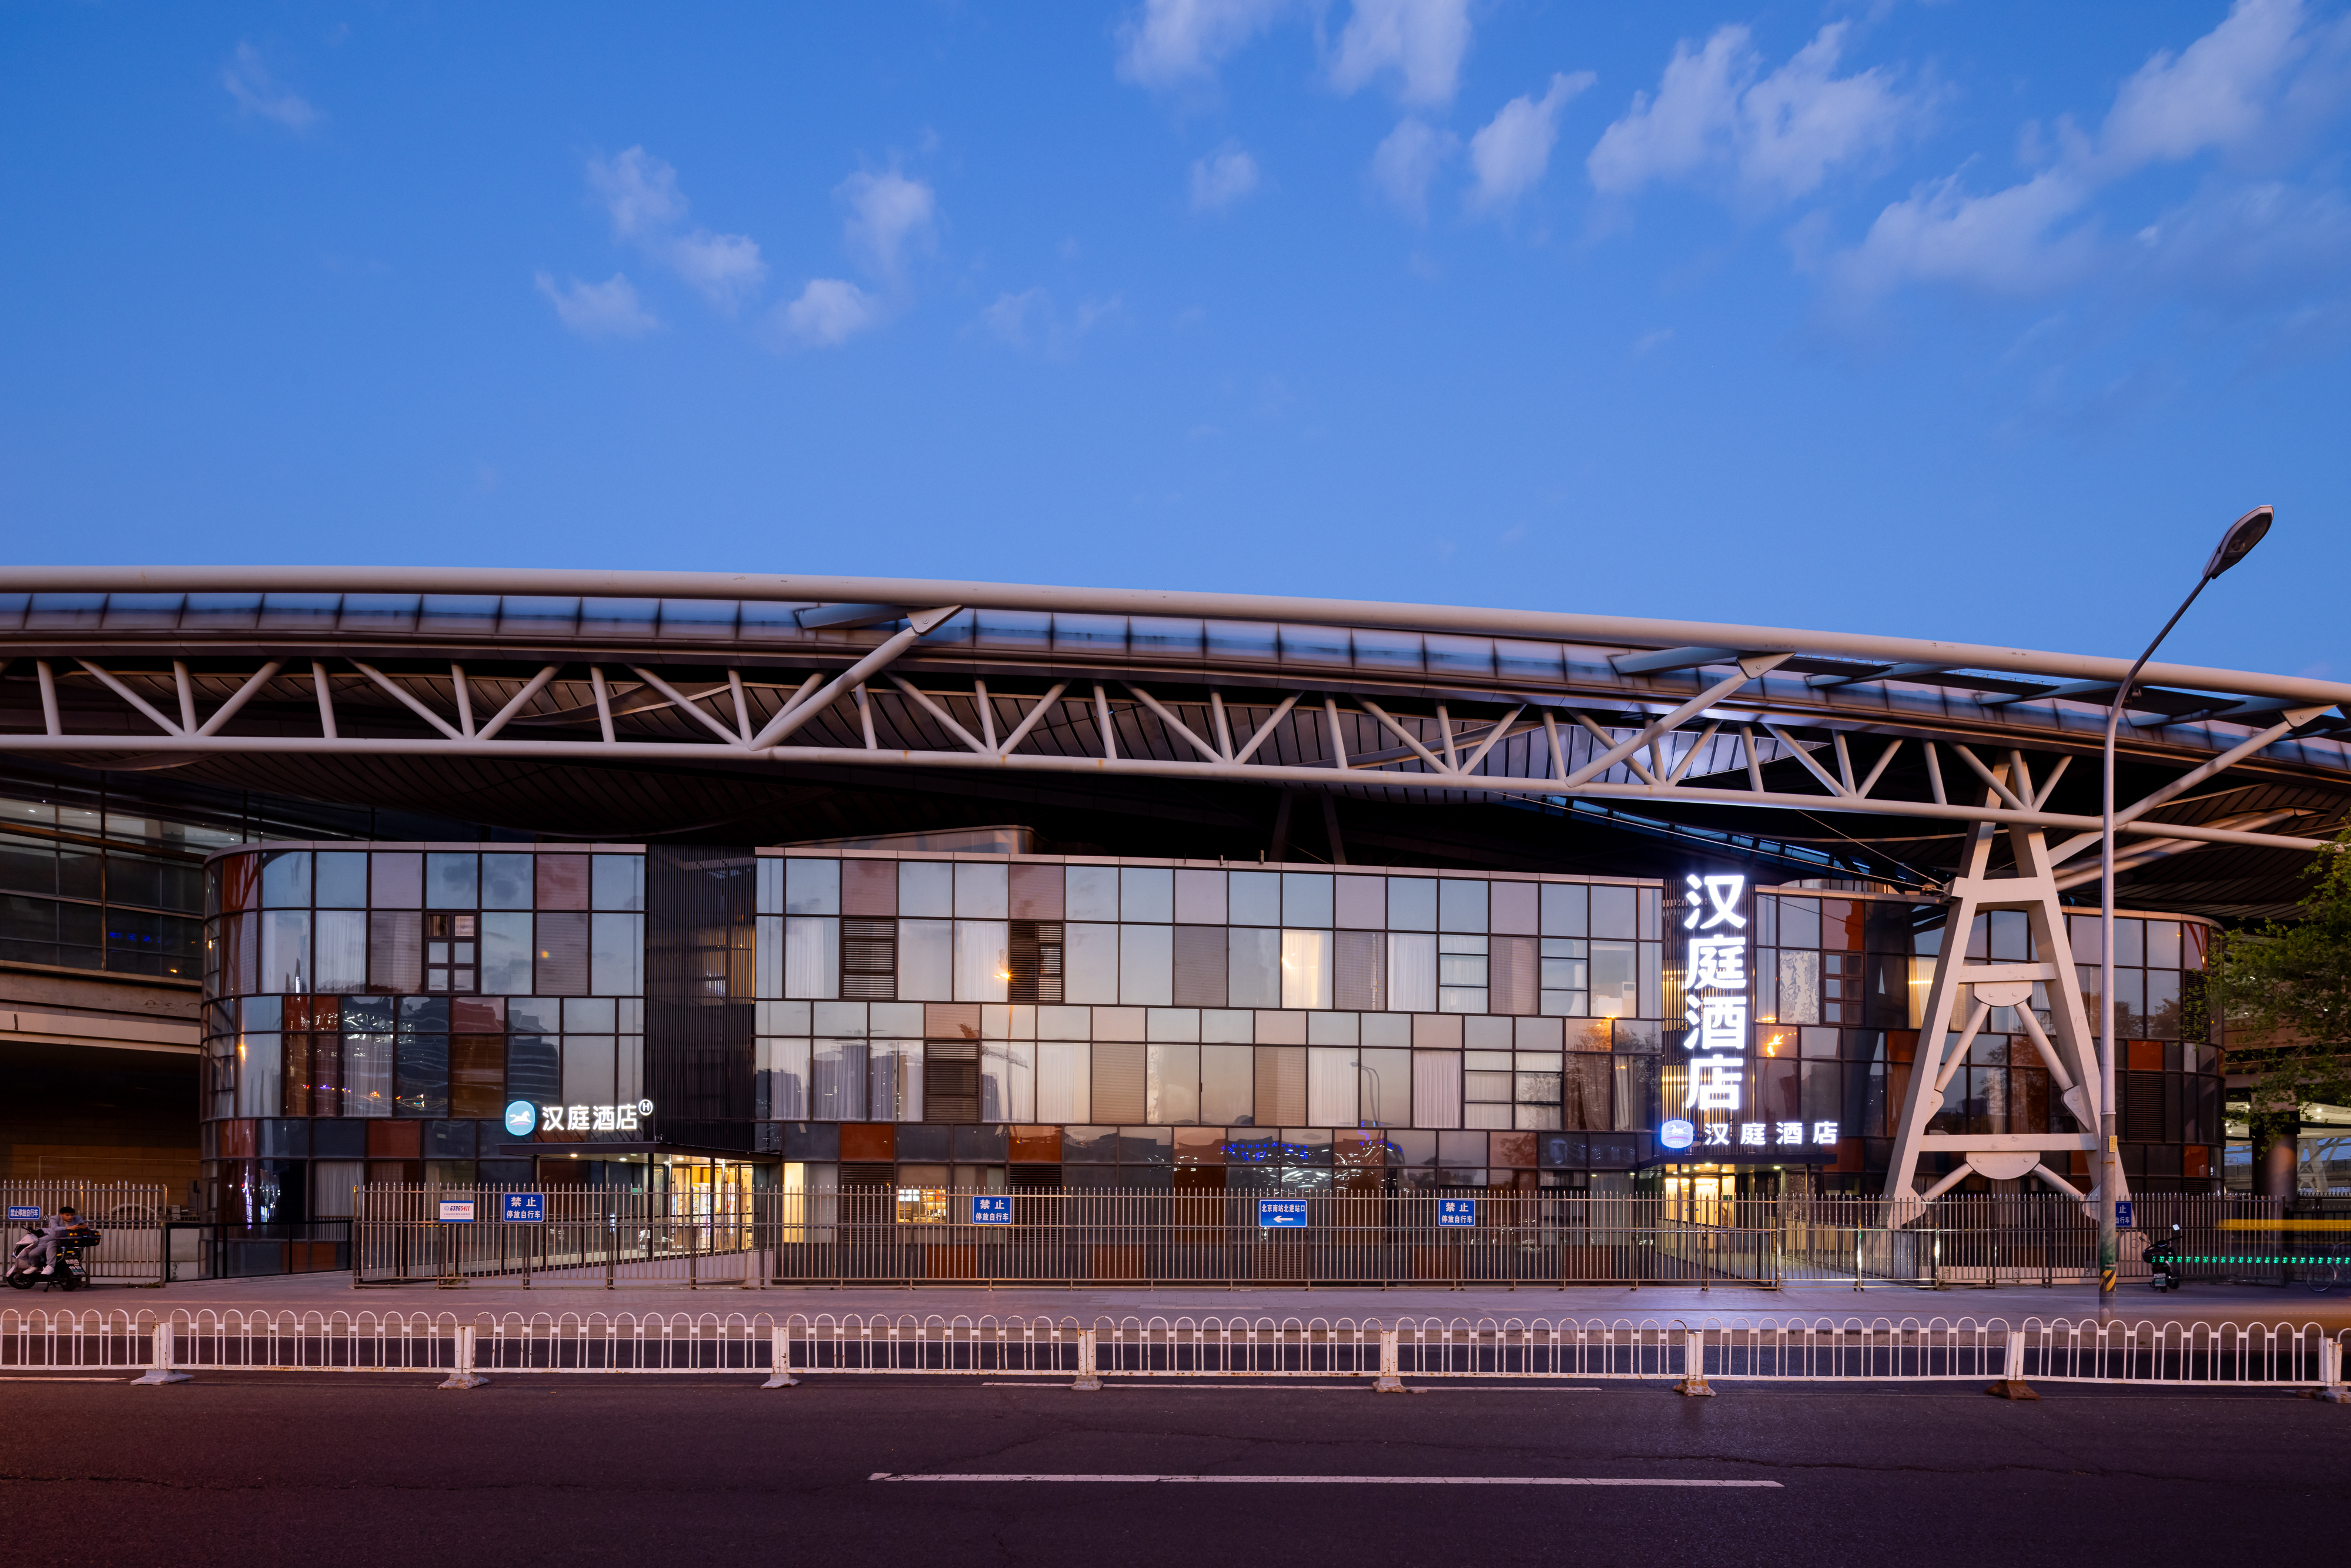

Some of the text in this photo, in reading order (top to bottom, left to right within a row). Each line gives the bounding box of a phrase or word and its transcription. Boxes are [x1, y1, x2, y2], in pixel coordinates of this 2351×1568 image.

[1684, 874, 1747, 1111] 汉庭酒店
[542, 1104, 637, 1131] 汉庭酒店
[1704, 1121, 1838, 1145] 汉庭酒店
[511, 1197, 537, 1207] 禁止
[980, 1199, 1005, 1209] 禁止
[1261, 1204, 1305, 1212] 北京南站北进站口
[1445, 1202, 1469, 1212] 禁止
[2118, 1205, 2127, 1213] 止
[10, 1208, 39, 1217] 禁止停放自行车
[506, 1210, 541, 1219] 停放自行车
[975, 1212, 1009, 1221] 停放自行车
[1441, 1215, 1473, 1224] 停放自行车
